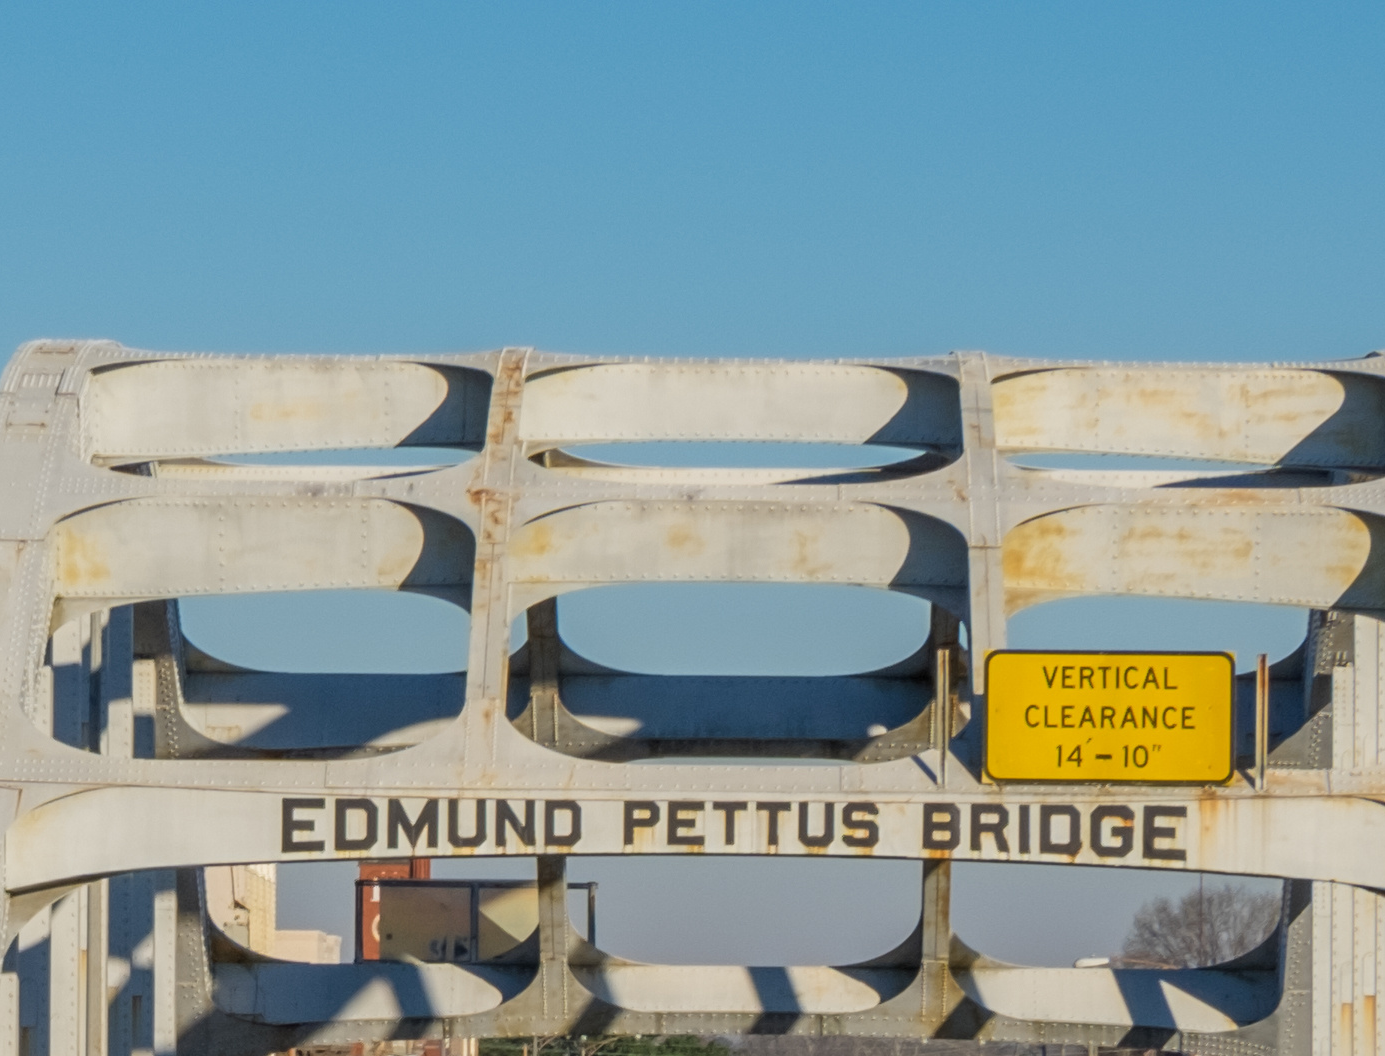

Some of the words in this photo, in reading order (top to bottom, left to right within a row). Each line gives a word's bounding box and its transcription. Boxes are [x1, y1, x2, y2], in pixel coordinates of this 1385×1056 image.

[1042, 665, 1178, 690] VERTICAL
[1024, 704, 1196, 730] CLEARANCE
[281, 797, 582, 853] EDMUND
[623, 800, 880, 849] PETTUS
[922, 802, 1188, 861] BRIDGE
